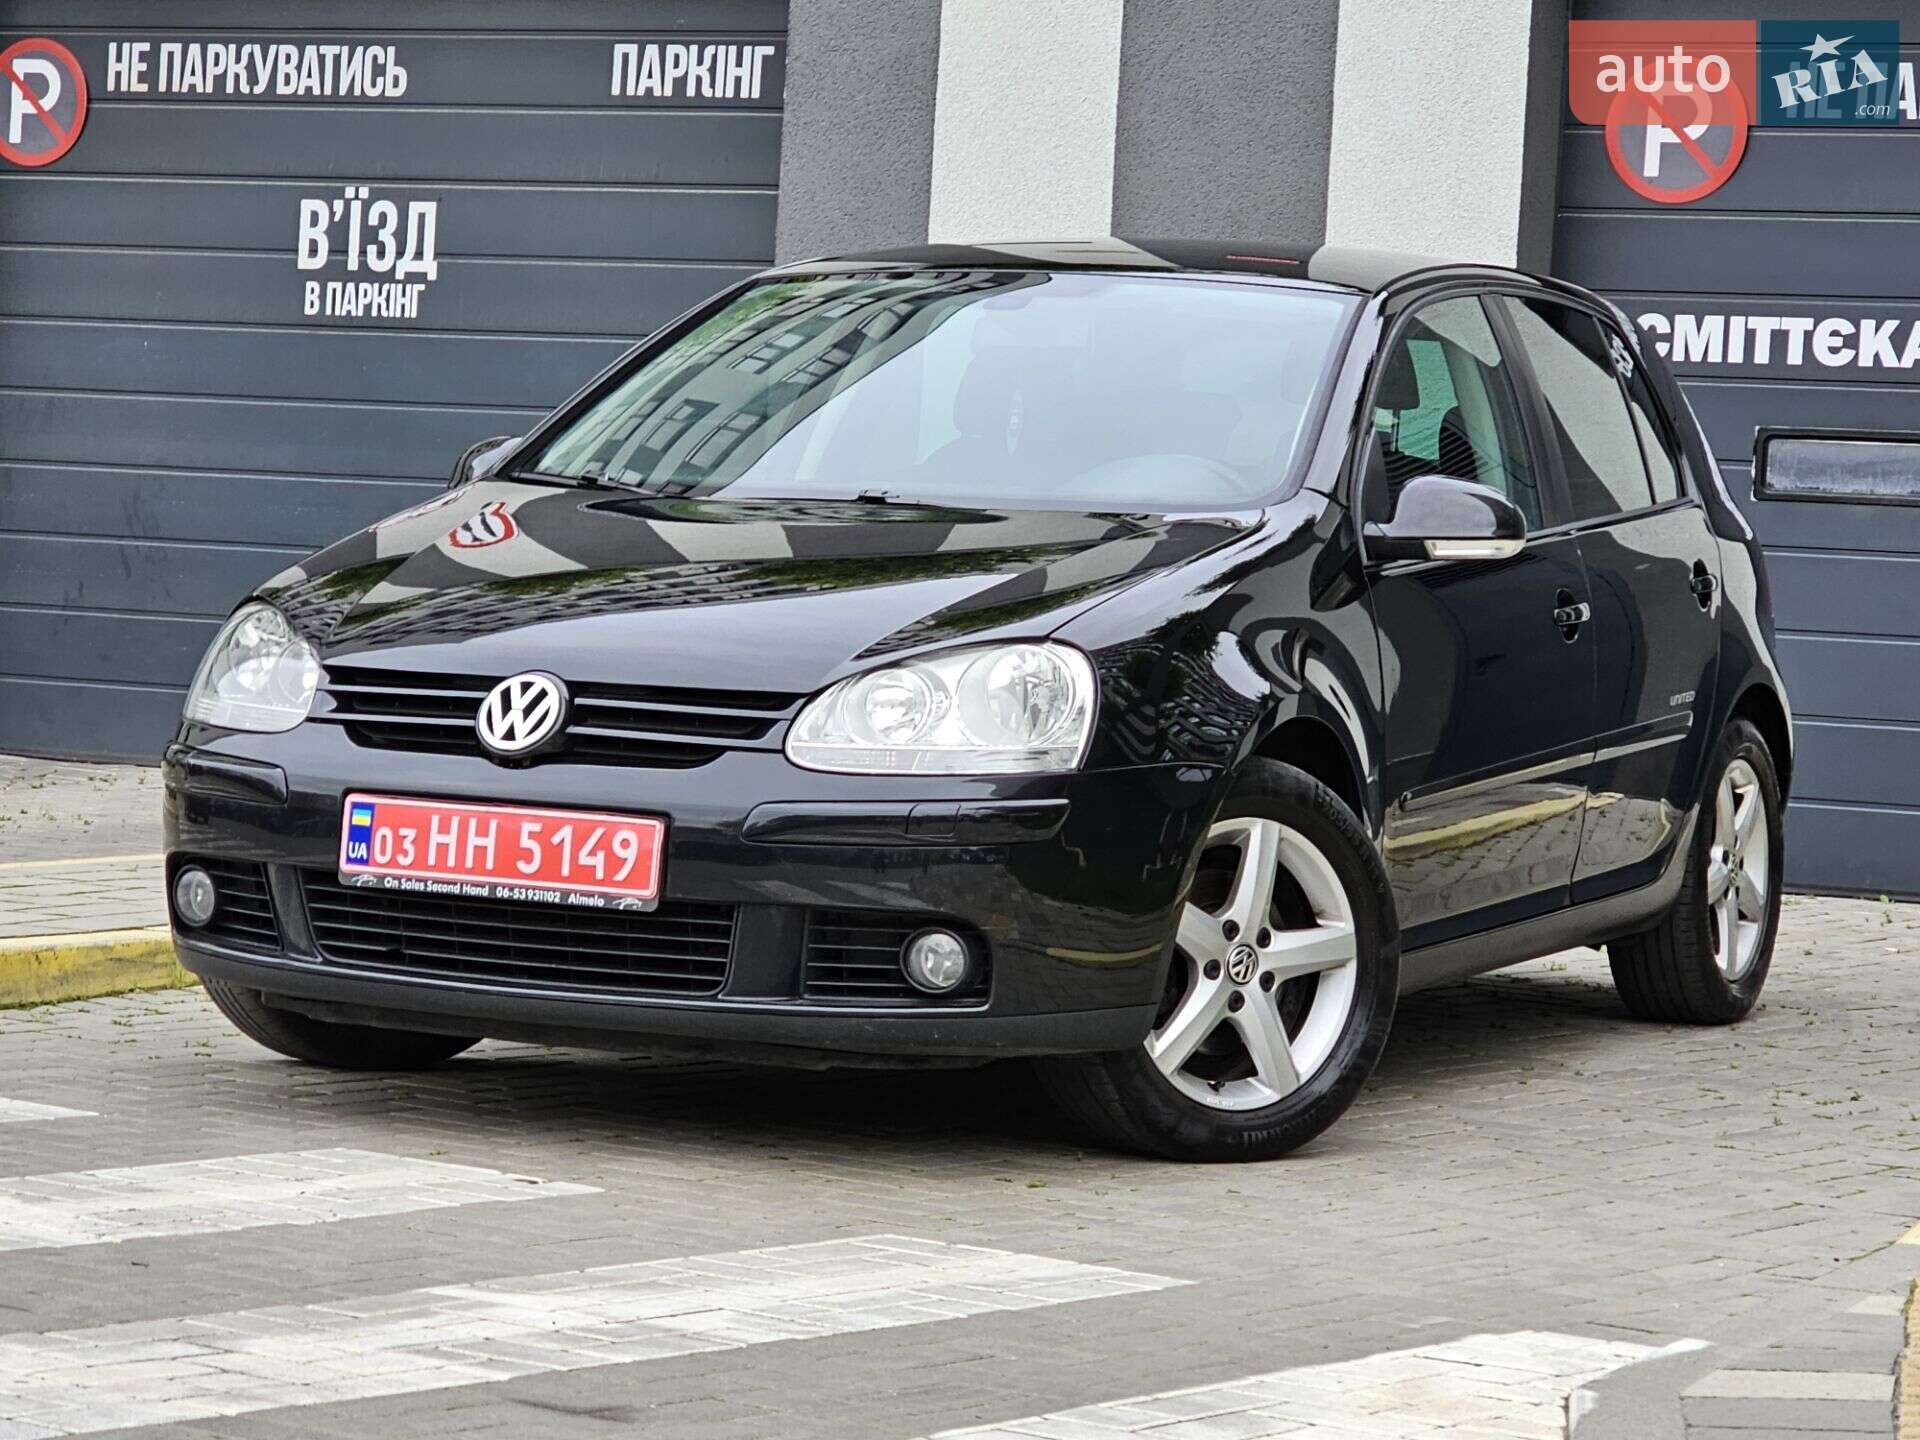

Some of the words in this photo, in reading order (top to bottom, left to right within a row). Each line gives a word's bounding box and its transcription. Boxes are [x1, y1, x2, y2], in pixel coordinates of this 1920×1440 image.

[107, 42, 150, 92] НЕ
[158, 43, 408, 97] ПАРКУВАТИСЬ
[611, 44, 775, 98] ПАРКІНГ
[297, 186, 438, 281] В'ЇЗД
[304, 280, 320, 316] В
[325, 281, 426, 319] ПАРКІНГ
[480, 676, 559, 748] VW
[347, 840, 368, 861] UA
[374, 826, 417, 866] 03
[427, 814, 498, 871] HH
[516, 821, 639, 882] 5149
[384, 876, 399, 889] On
[401, 878, 426, 891] Sales
[427, 879, 461, 894] Second
[463, 885, 489, 897] Hand
[567, 893, 605, 907] Almelo
